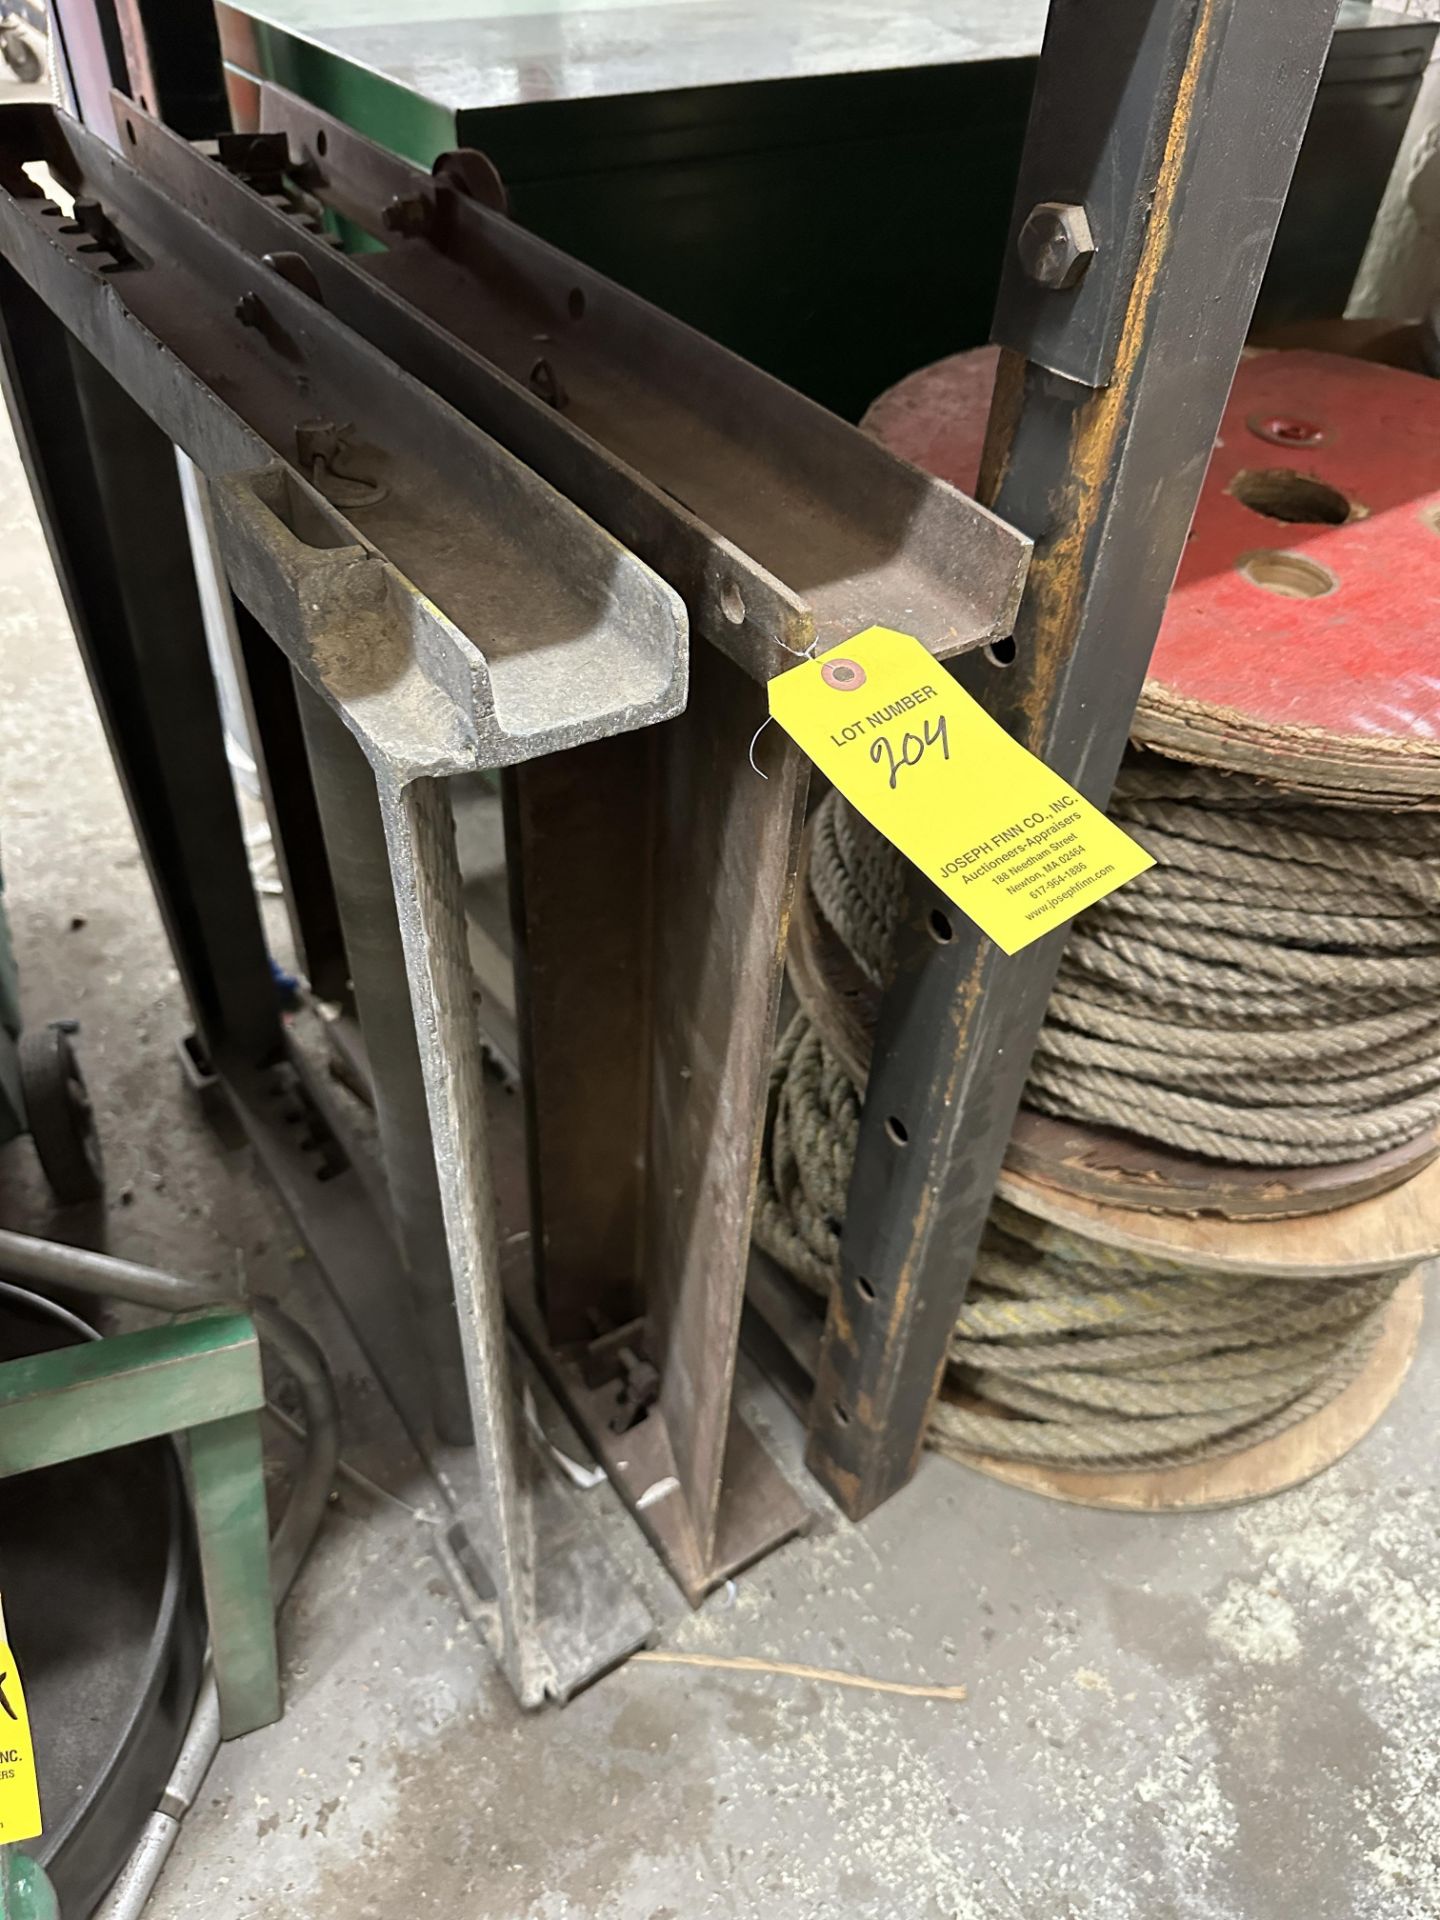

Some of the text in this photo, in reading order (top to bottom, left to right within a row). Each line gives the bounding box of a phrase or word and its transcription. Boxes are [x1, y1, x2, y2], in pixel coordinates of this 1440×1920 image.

[830, 685, 938, 748] LOT NUMBER
[870, 714, 950, 790] 204
[940, 795, 1079, 879] JOSEPH FINN CO., INC.
[961, 811, 1082, 885] Auctioneers-Appraisers
[991, 832, 1079, 886] 188 Needham Street
[1006, 844, 1086, 895] Newton, MA 02464
[1025, 863, 1115, 921] www.josephfinn.com
[1029, 862, 1088, 900] 617-964-1886
[0, 1749, 23, 1763] NC.
